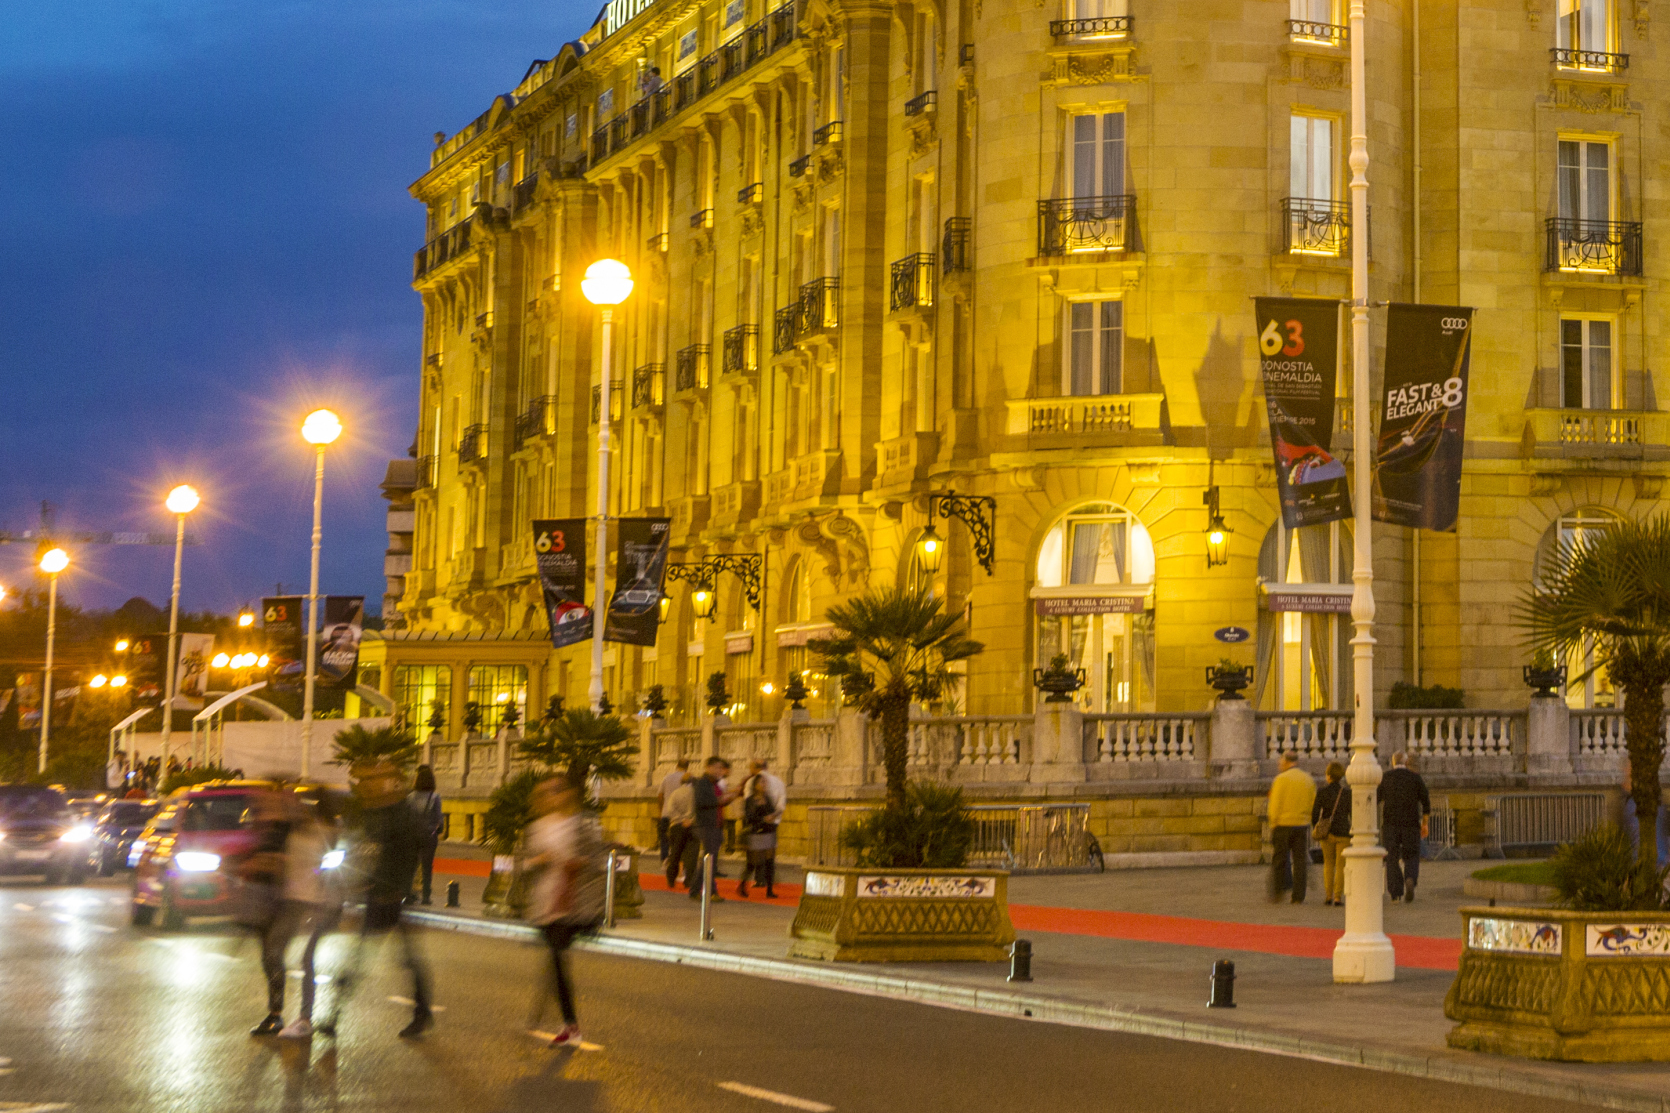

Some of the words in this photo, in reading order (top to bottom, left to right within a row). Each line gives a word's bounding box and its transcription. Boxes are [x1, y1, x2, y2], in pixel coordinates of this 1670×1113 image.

[1260, 318, 1305, 357] 63
[1263, 371, 1322, 383] NEMALDIA
[1387, 382, 1432, 407] FAST
[1431, 382, 1443, 398] &
[1442, 377, 1463, 407] 8
[1386, 397, 1443, 421] ELEGANT
[536, 529, 566, 553] 63
[1045, 599, 1069, 607] HOTEL
[1072, 598, 1097, 607] MARIA
[1099, 597, 1135, 607] CRISTINA
[1277, 595, 1299, 604] HOTEL
[1301, 596, 1323, 604] MARIA
[1325, 597, 1352, 605] CRISTIN
[264, 605, 288, 623] 63
